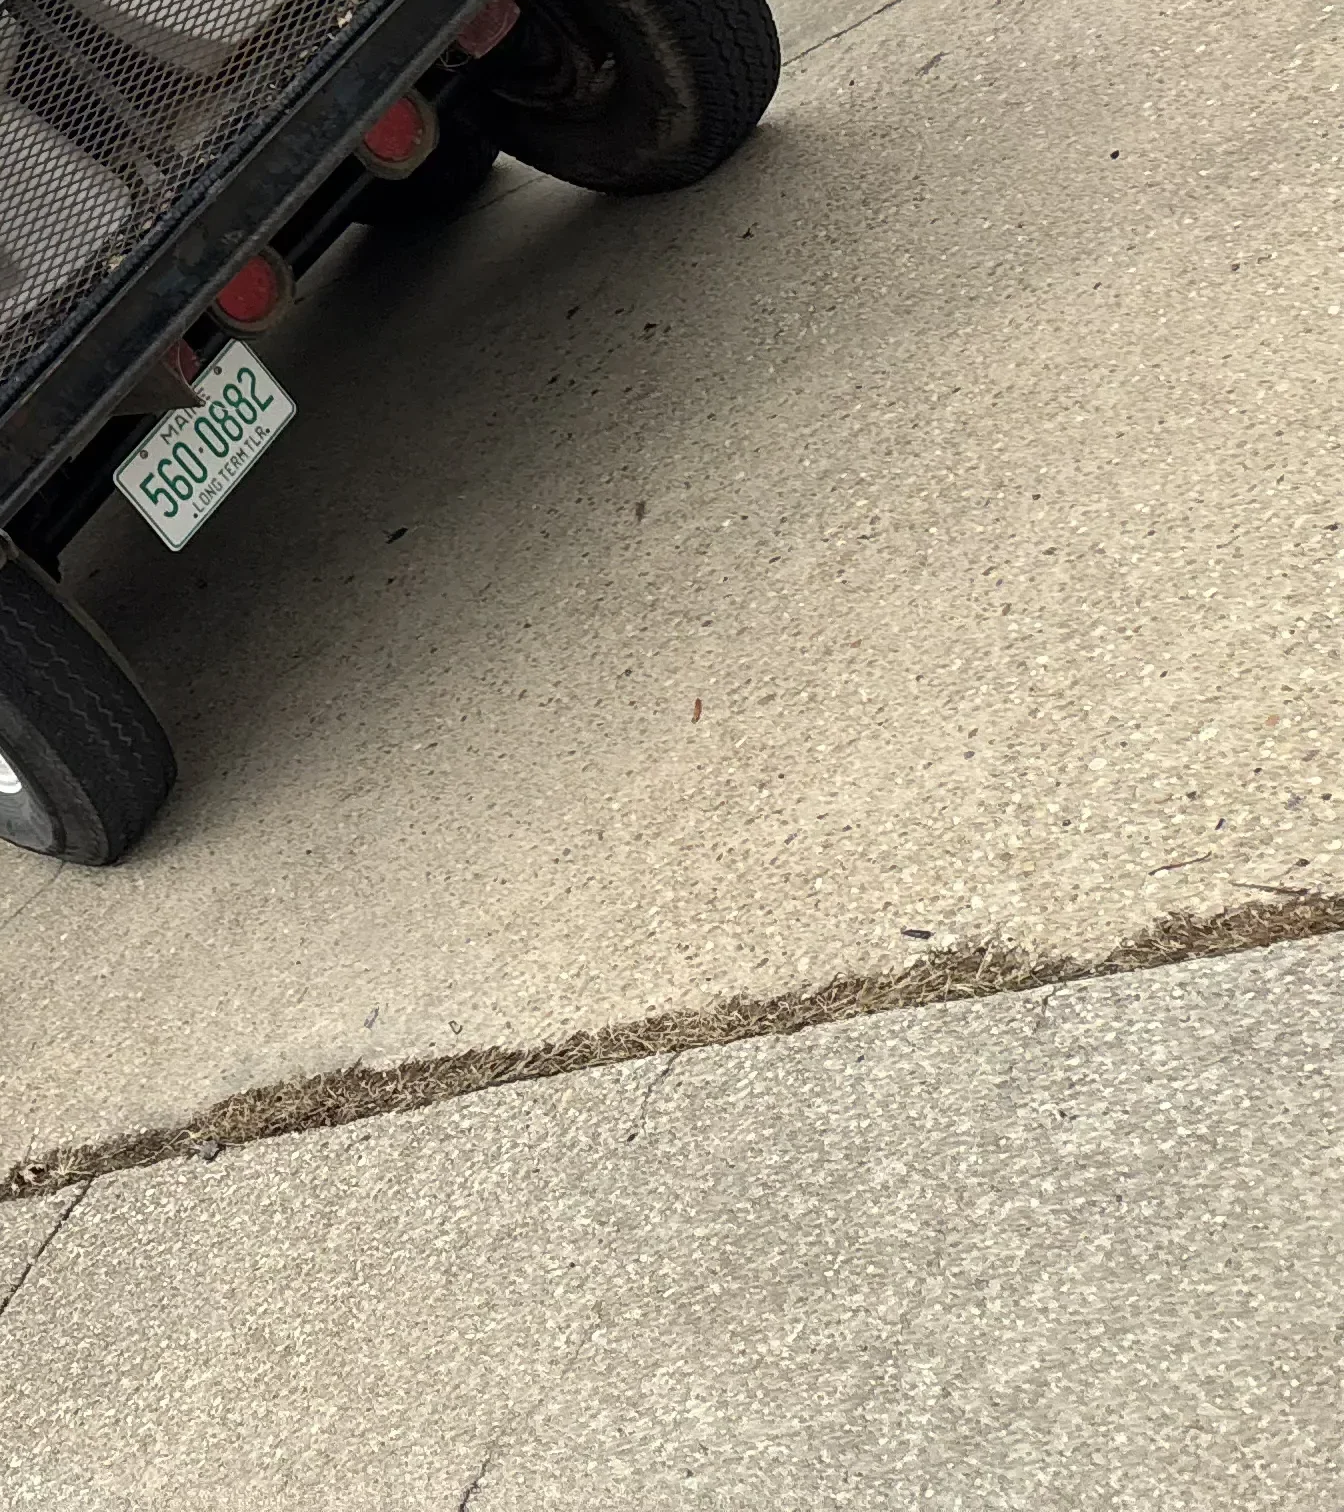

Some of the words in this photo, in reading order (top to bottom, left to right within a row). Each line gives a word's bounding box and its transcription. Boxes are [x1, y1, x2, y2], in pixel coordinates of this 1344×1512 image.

[160, 387, 211, 445] MAIE
[192, 477, 223, 513] LONG
[218, 447, 250, 482] TERM
